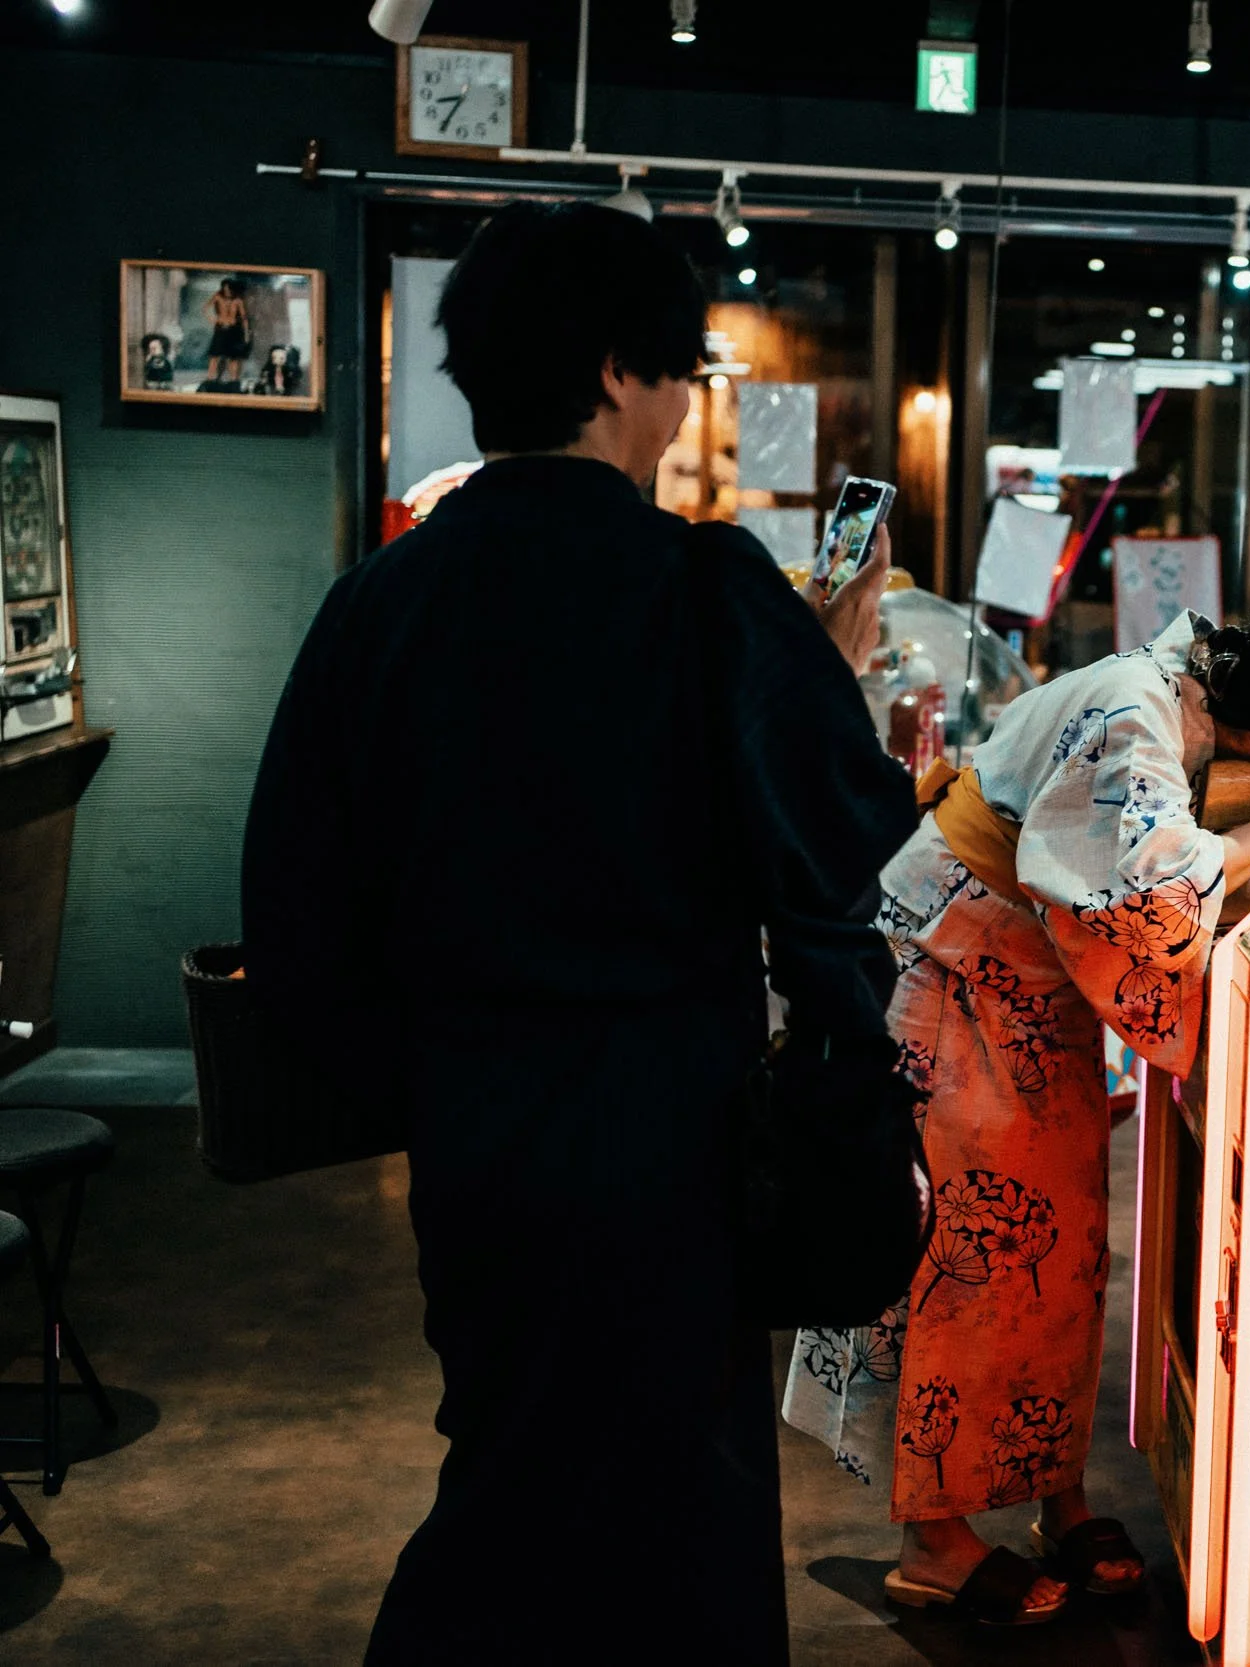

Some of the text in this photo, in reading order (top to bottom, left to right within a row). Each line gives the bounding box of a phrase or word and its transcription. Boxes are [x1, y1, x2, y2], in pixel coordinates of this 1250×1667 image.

[420, 88, 432, 100] 9
[494, 92, 506, 106] 3
[488, 110, 499, 124] 4
[455, 125, 469, 140] 6
